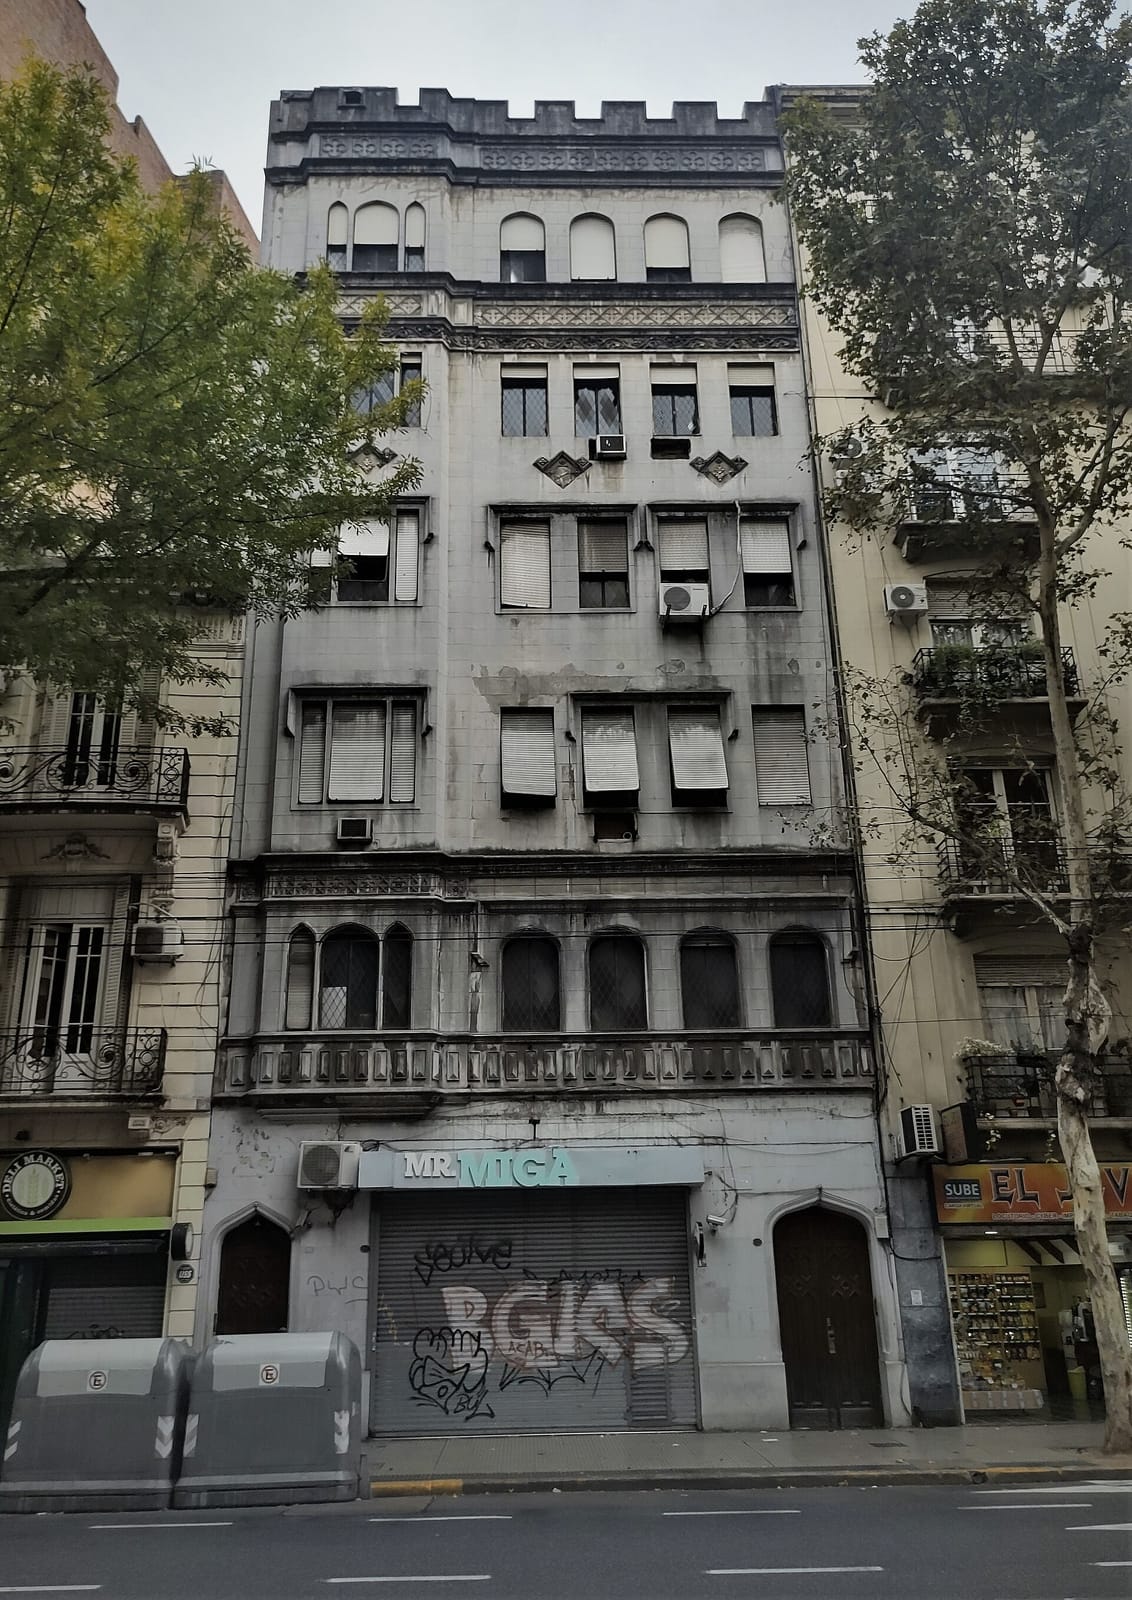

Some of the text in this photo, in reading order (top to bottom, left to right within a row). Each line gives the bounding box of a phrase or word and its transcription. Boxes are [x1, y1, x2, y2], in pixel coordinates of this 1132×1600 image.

[2, 1154, 65, 1193] DELI MARKET
[457, 1147, 576, 1187] MIGA
[944, 1183, 980, 1196] SUBE
[989, 1167, 1040, 1209] EL
